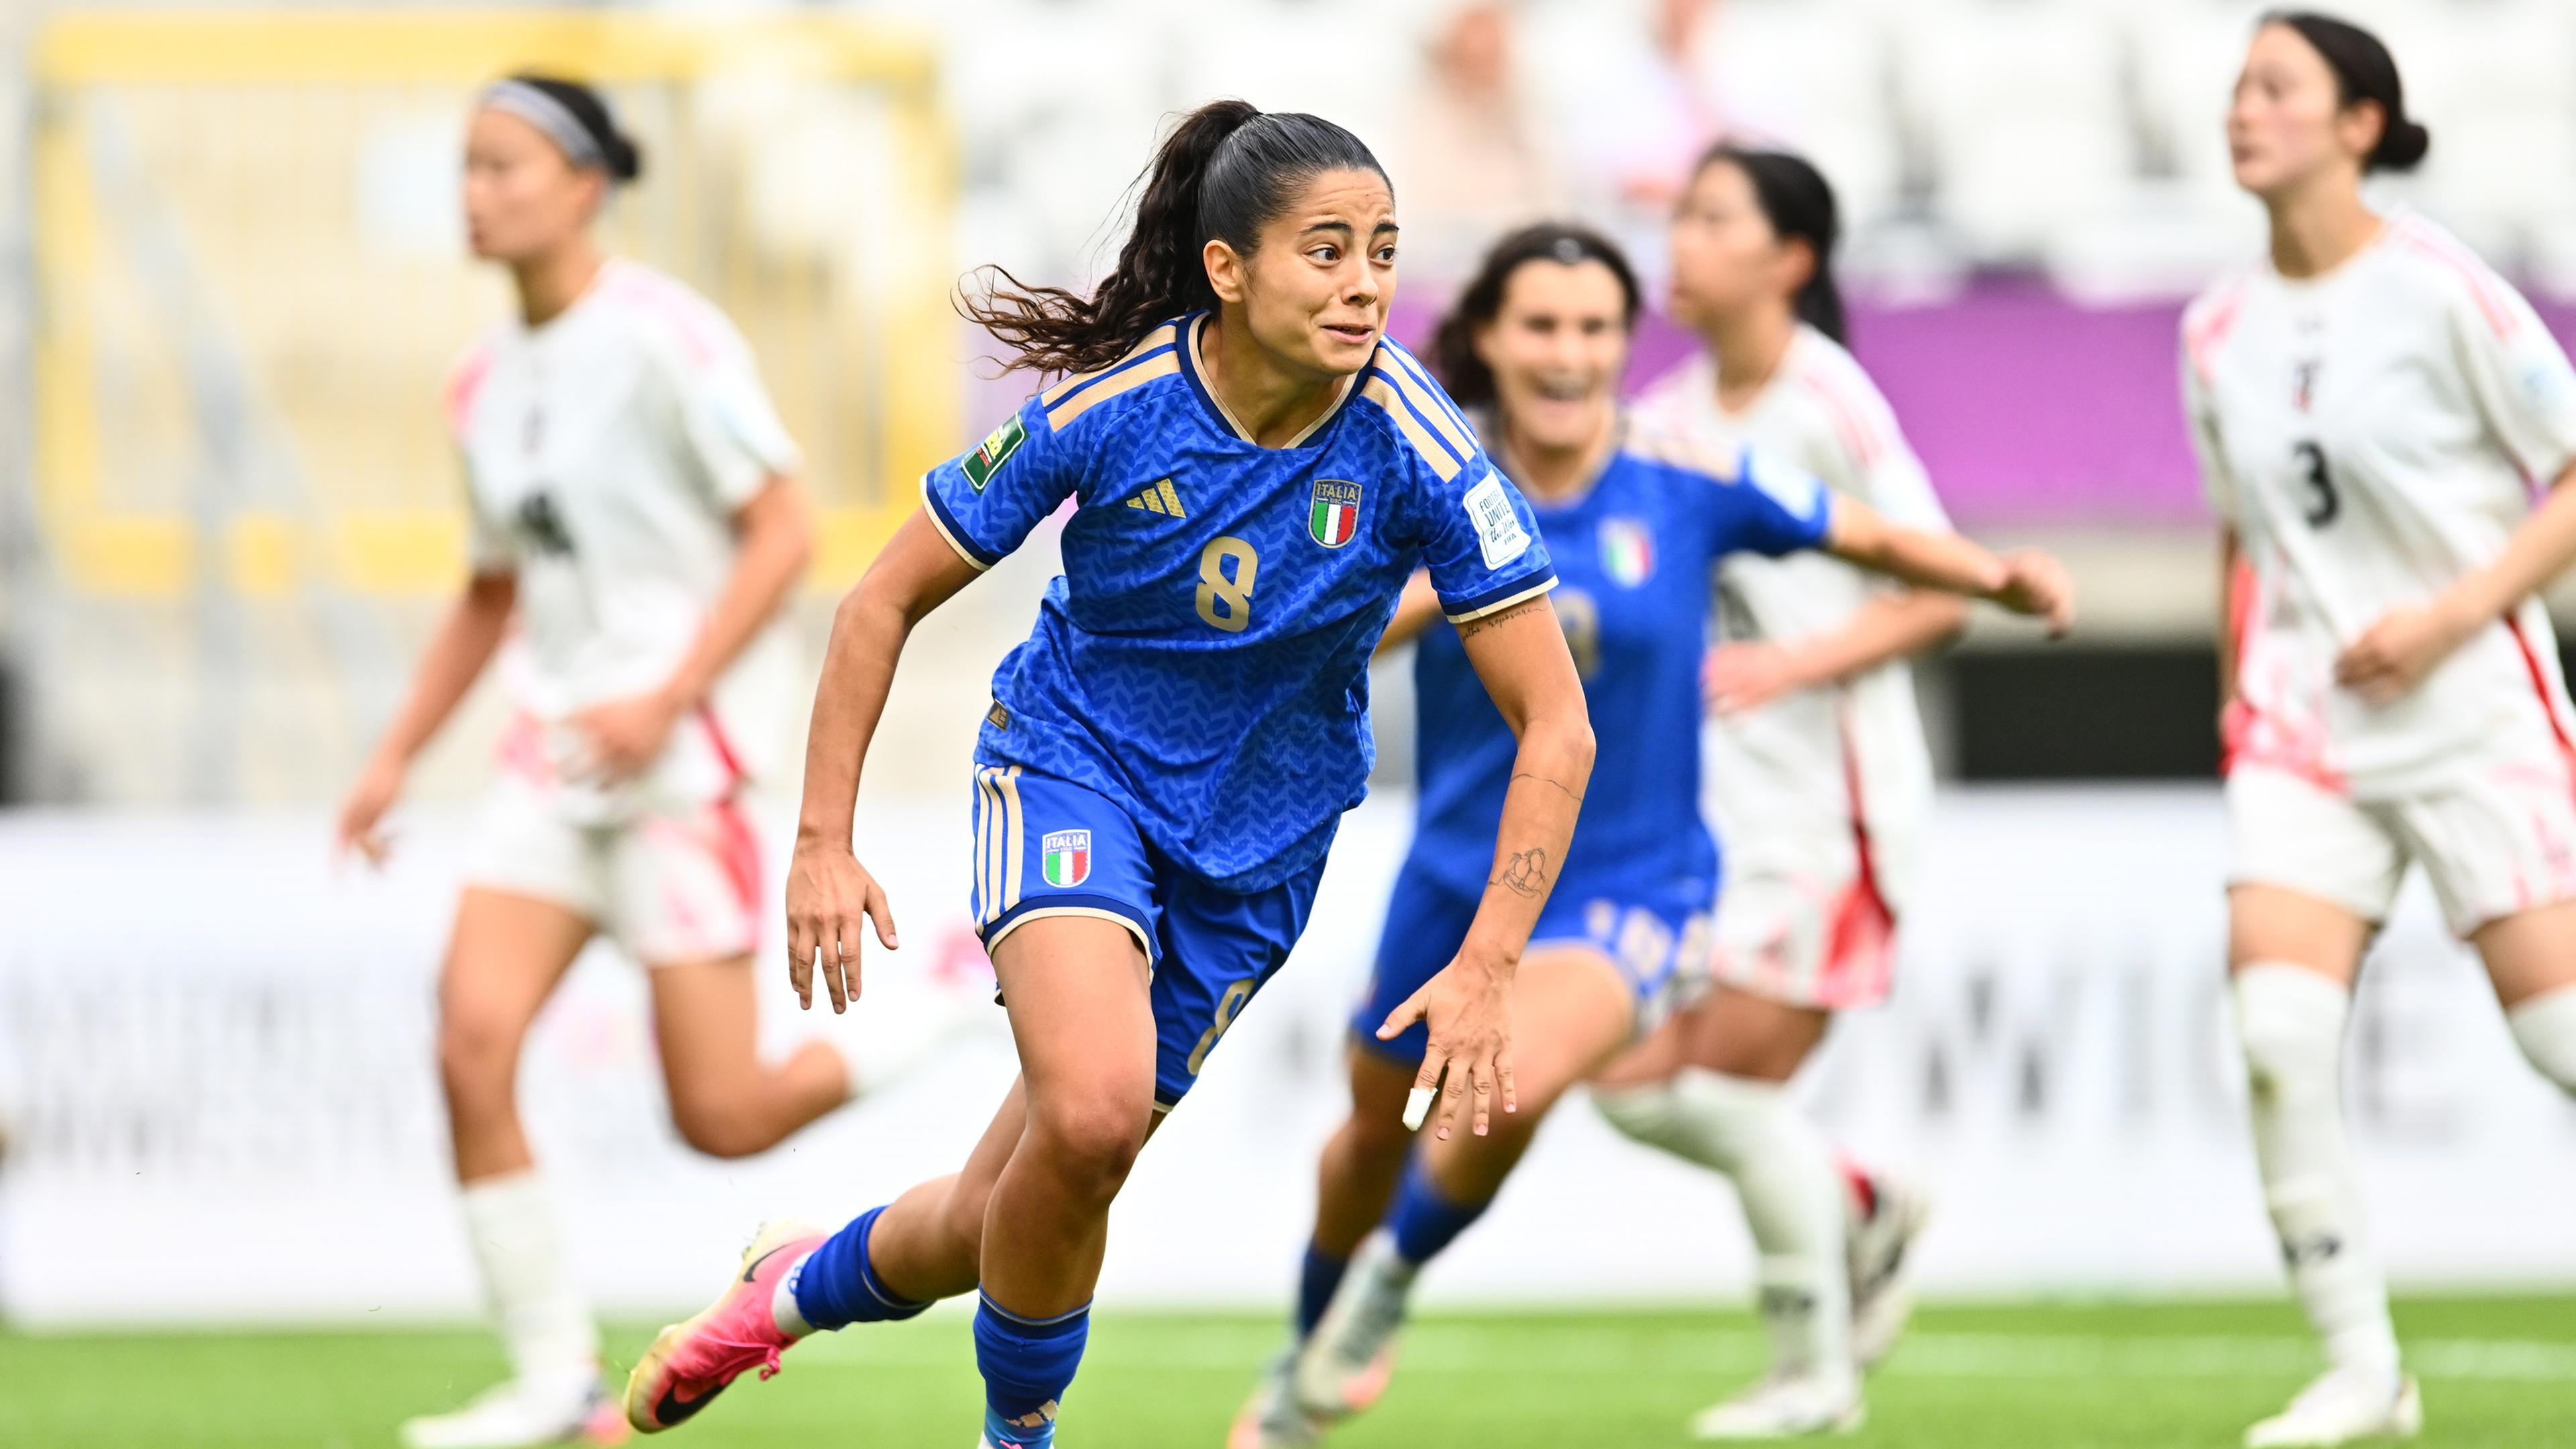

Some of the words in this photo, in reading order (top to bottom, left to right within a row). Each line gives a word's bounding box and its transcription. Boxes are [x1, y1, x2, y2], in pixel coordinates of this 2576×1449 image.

[1316, 483, 1356, 500] ITALIA
[2292, 439, 2340, 526] 3
[1195, 536, 1258, 633] 8
[1046, 835, 1087, 849] ITALIA
